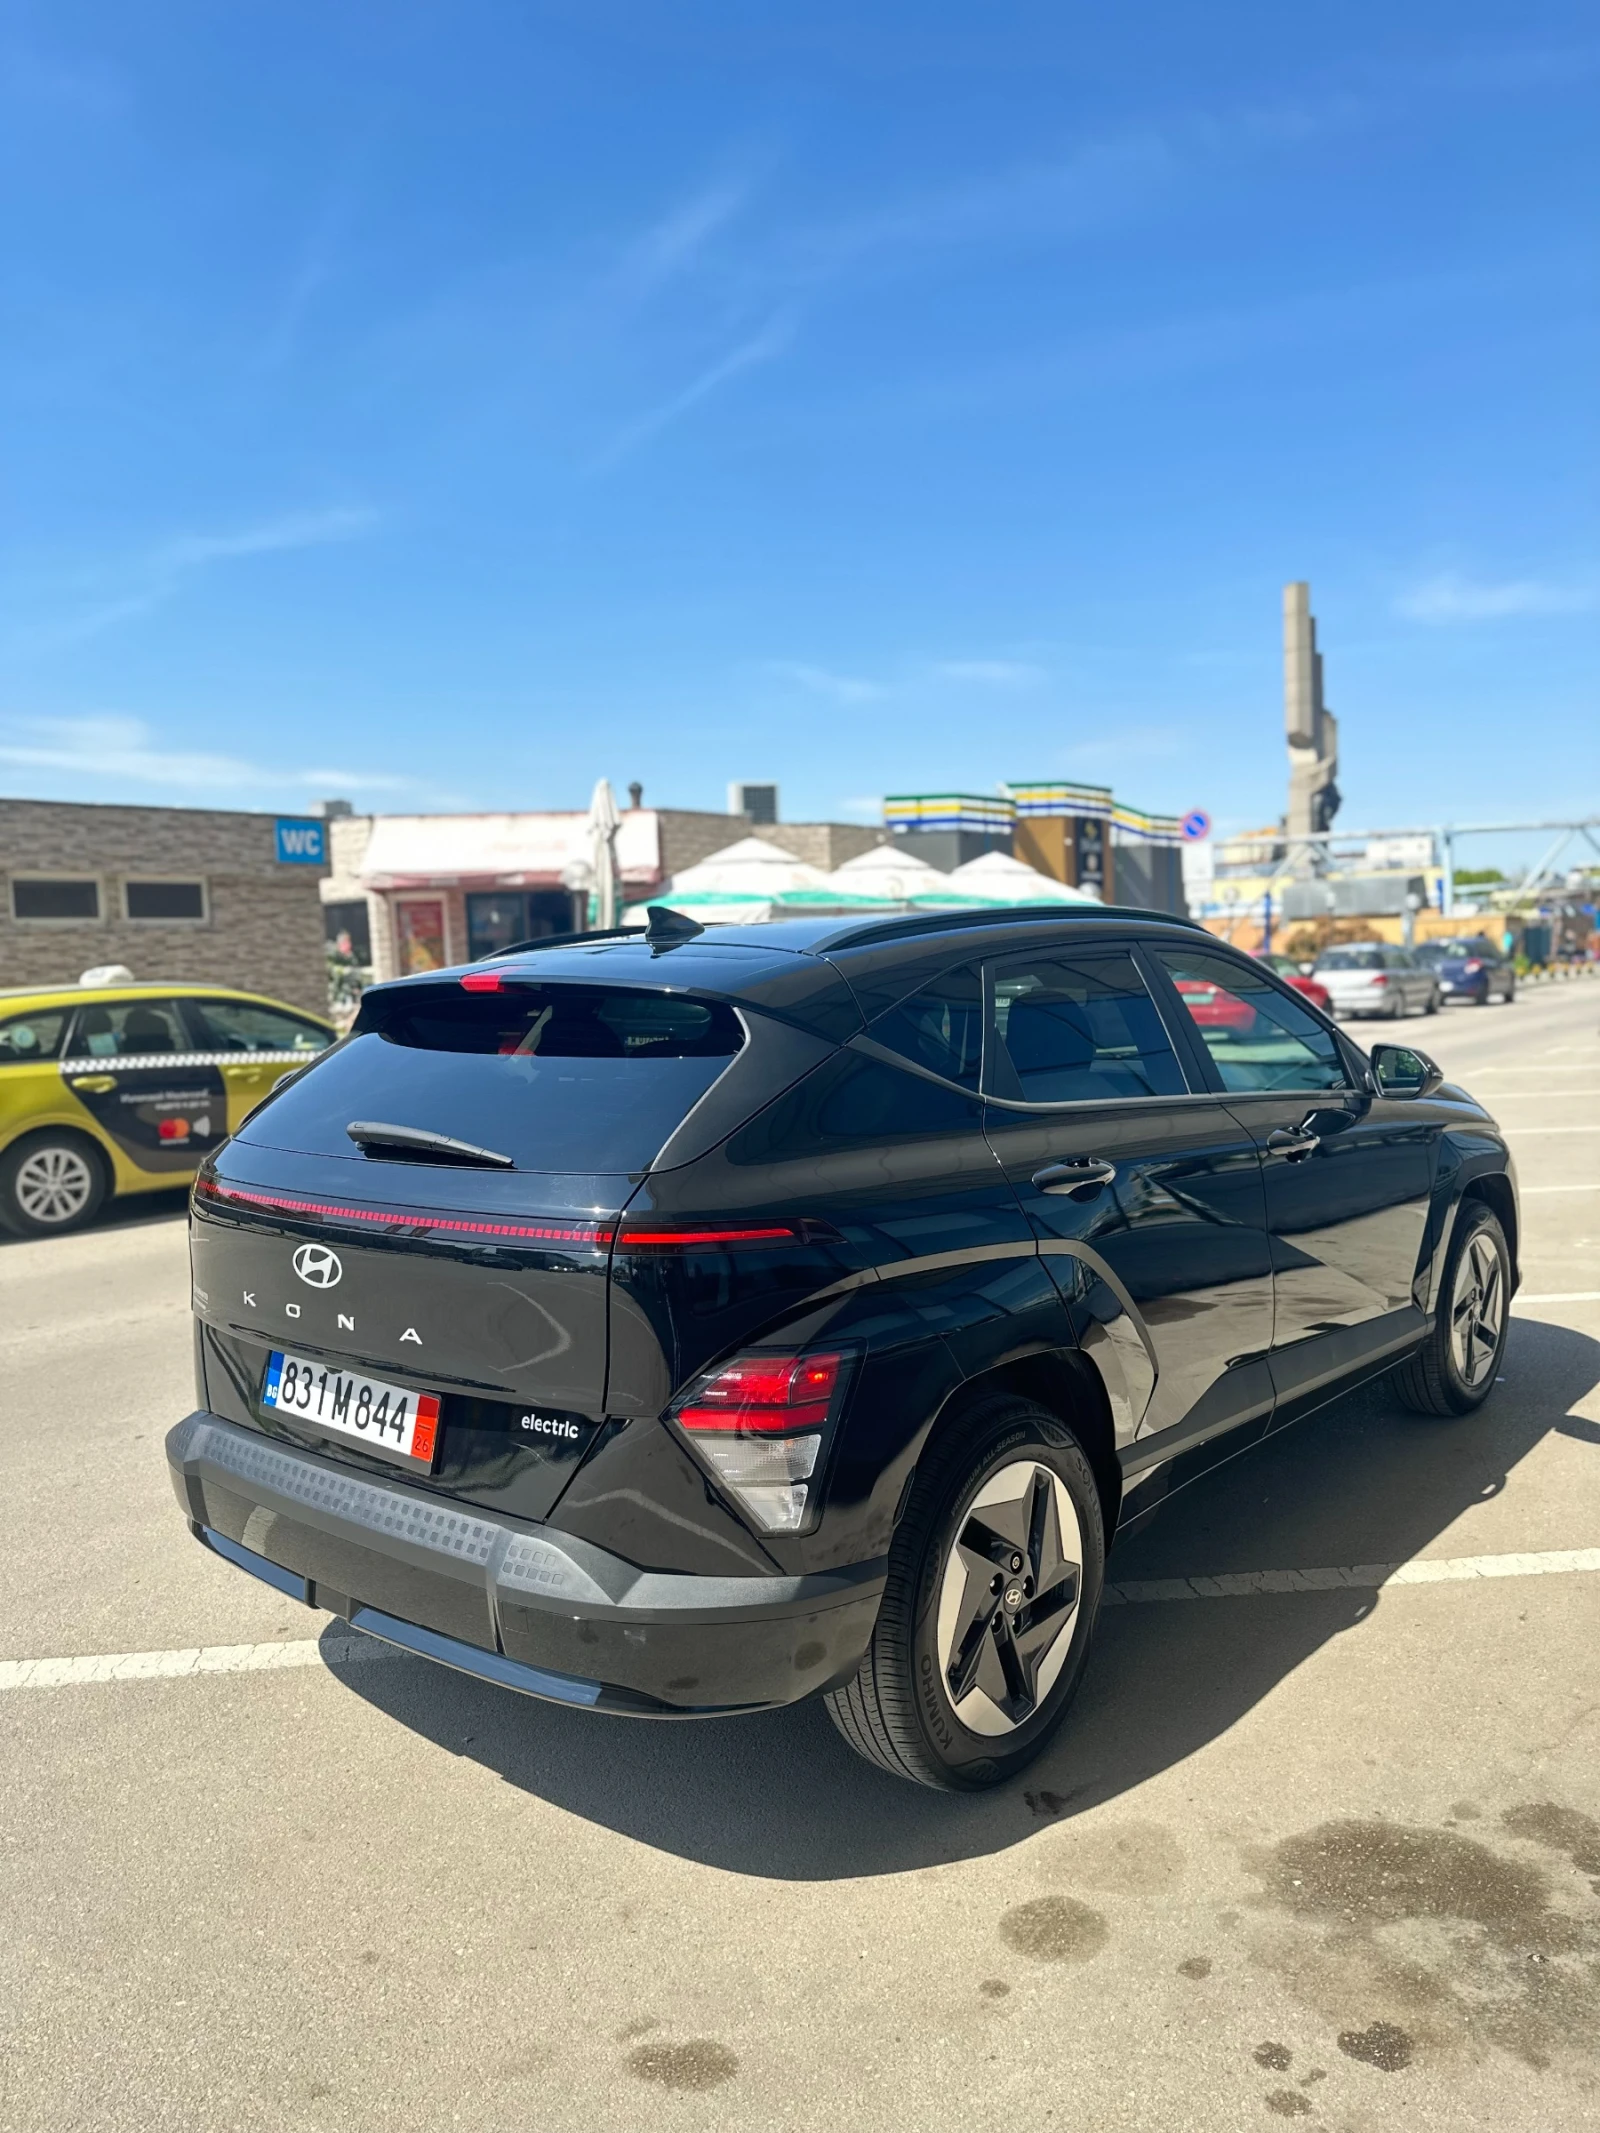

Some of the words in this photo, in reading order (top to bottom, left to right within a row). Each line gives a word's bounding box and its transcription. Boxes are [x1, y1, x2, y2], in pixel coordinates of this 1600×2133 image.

[281, 828, 320, 855] WC
[243, 1291, 422, 1345] KONA
[266, 1384, 278, 1399] BG
[521, 1413, 579, 1438] electric
[414, 1434, 429, 1453] 26
[951, 1463, 983, 1517] PREMIUM
[982, 1430, 1027, 1466] ALL-SEASON
[921, 1653, 954, 1751] KUMHO
